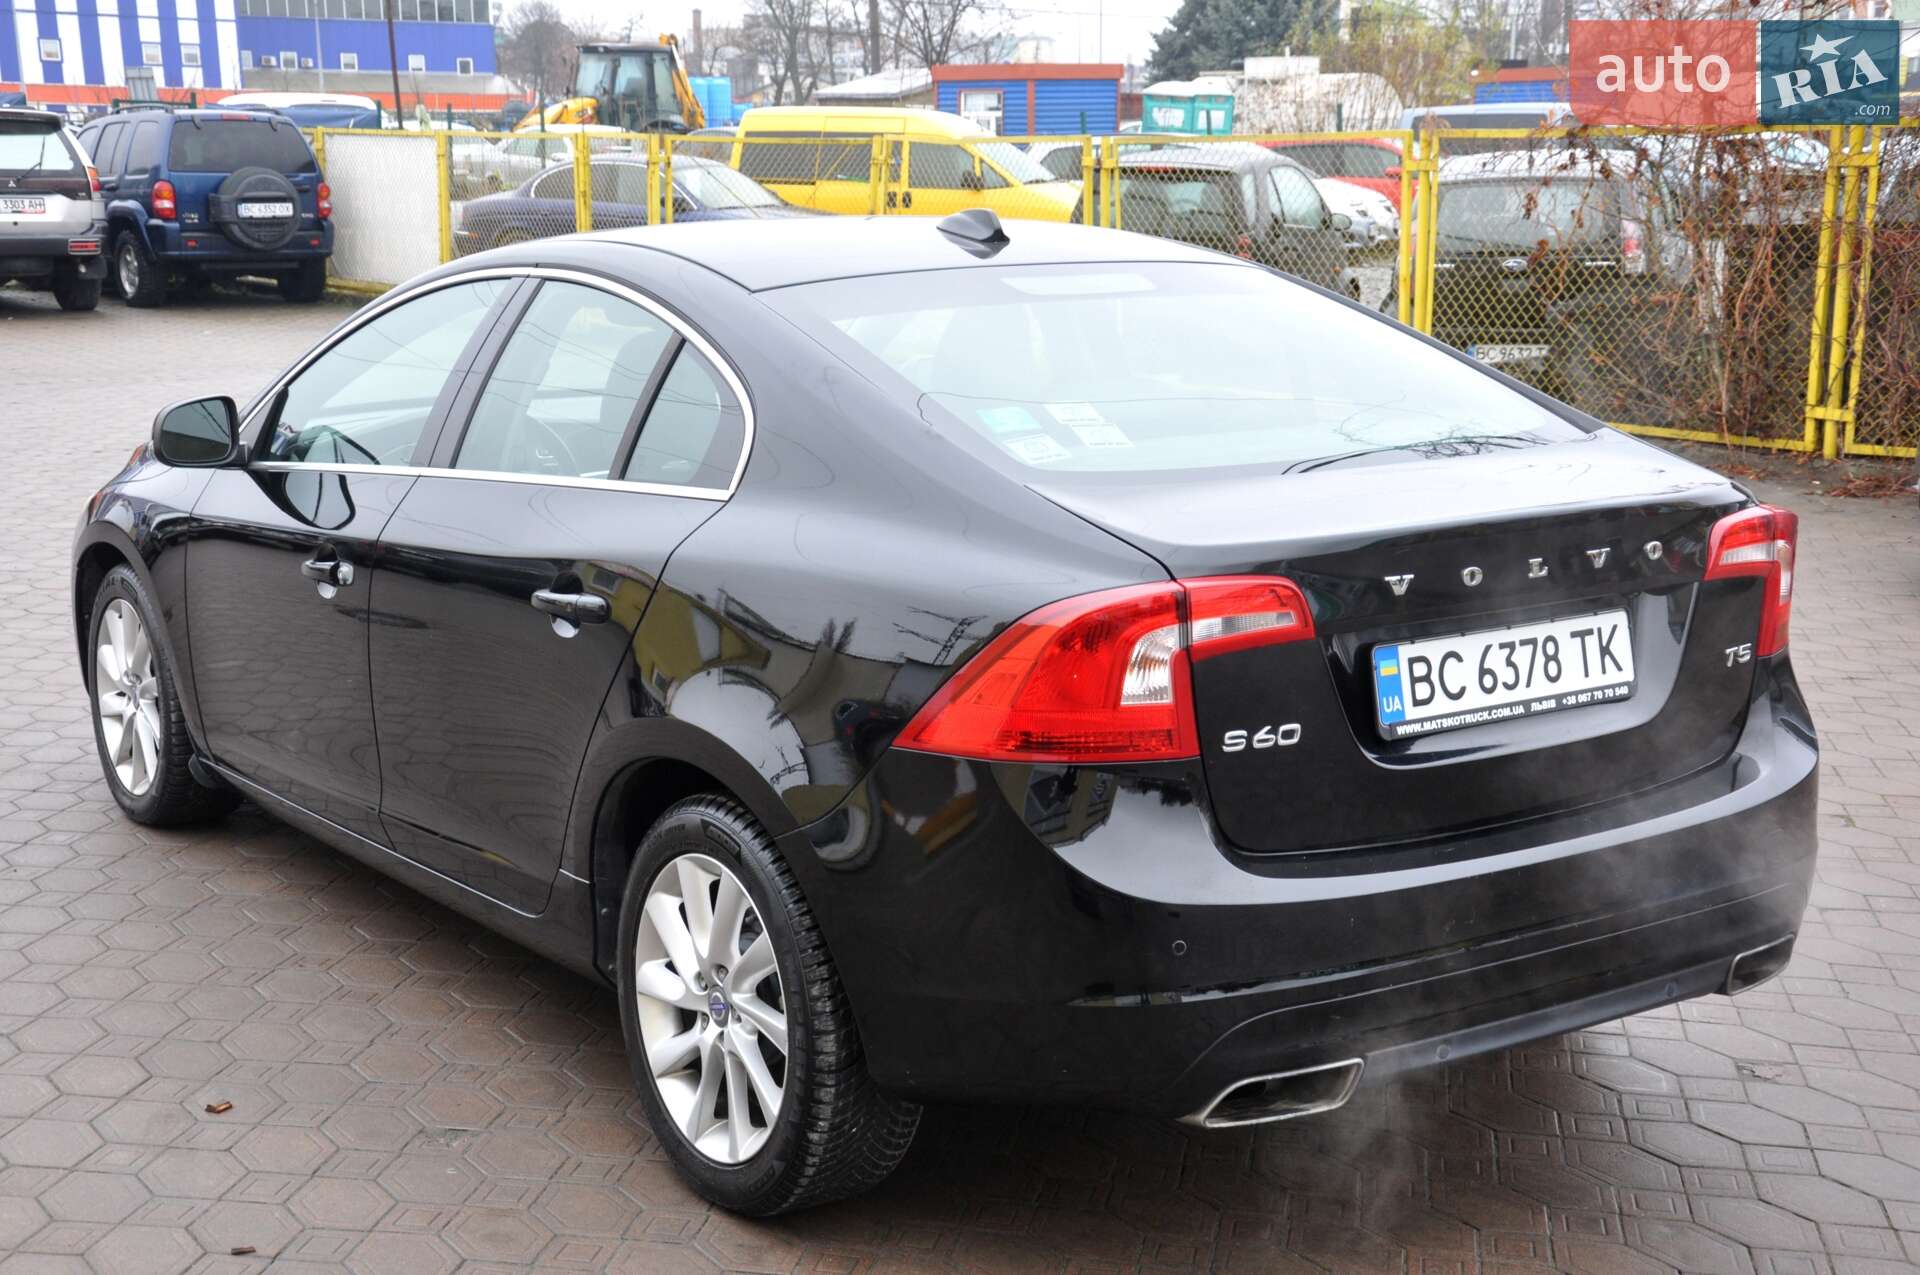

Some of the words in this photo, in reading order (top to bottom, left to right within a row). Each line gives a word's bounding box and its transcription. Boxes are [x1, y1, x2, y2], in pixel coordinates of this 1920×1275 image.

[1384, 540, 1664, 597] VOLVO
[1408, 650, 1467, 707] BC
[1478, 635, 1563, 695] 6378
[1570, 624, 1623, 678] TK
[1725, 643, 1752, 667] T5
[1384, 695, 1403, 713] UA
[1396, 705, 1525, 735] WWW.MATSKOTRUCK.COM.UA
[1562, 694, 1577, 706] +38
[1578, 691, 1593, 703] 067
[1594, 689, 1604, 701] 70
[1604, 687, 1614, 699] 70
[1222, 723, 1301, 752] S60
